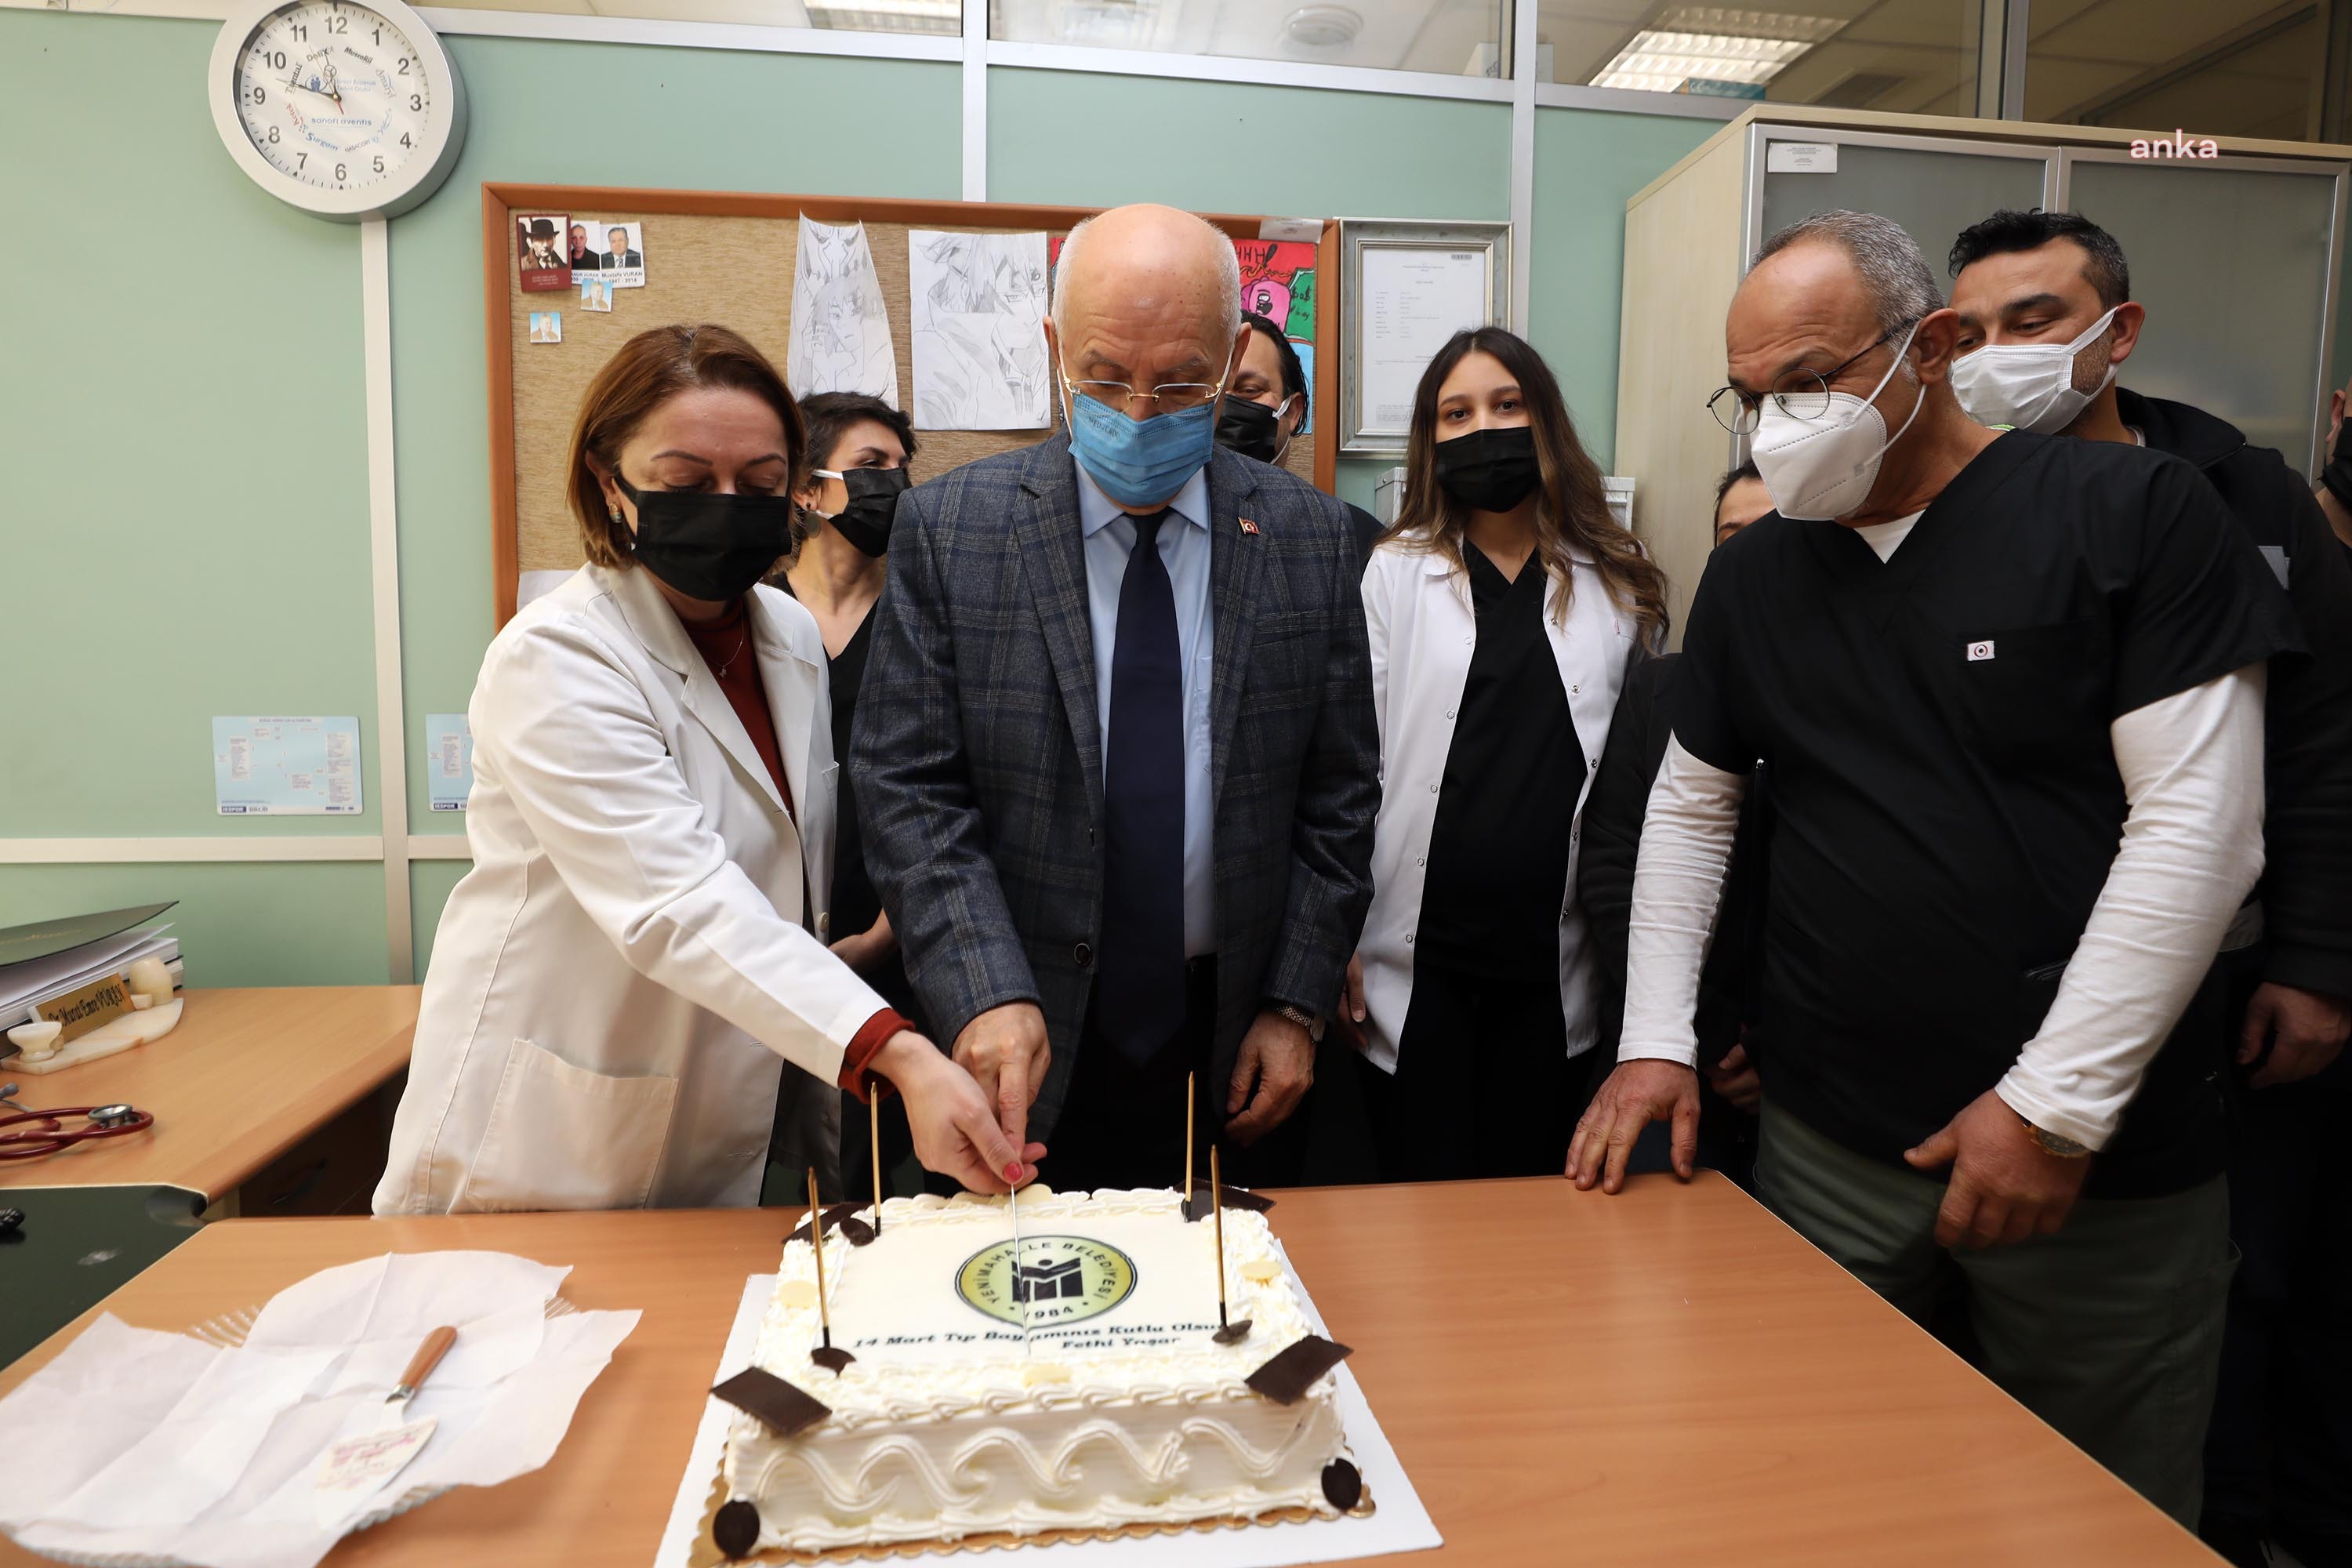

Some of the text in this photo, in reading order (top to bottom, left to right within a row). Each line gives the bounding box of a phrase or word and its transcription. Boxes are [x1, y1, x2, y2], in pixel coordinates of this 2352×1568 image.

[291, 25, 307, 42] 11
[325, 16, 347, 34] 12
[372, 29, 379, 45] 1
[263, 52, 286, 70] 10
[397, 58, 409, 75] 2
[253, 87, 265, 104] 9
[410, 95, 422, 111] 3
[311, 118, 372, 126] sanofi aventis
[268, 126, 281, 144] 8
[400, 132, 412, 149] 4
[296, 152, 308, 170] 7
[372, 156, 384, 173] 5
[335, 164, 347, 181] 6
[886, 1334, 935, 1345] Mart
[1109, 1324, 1163, 1334] Kutlu
[1062, 1339, 1113, 1349] Fethi
